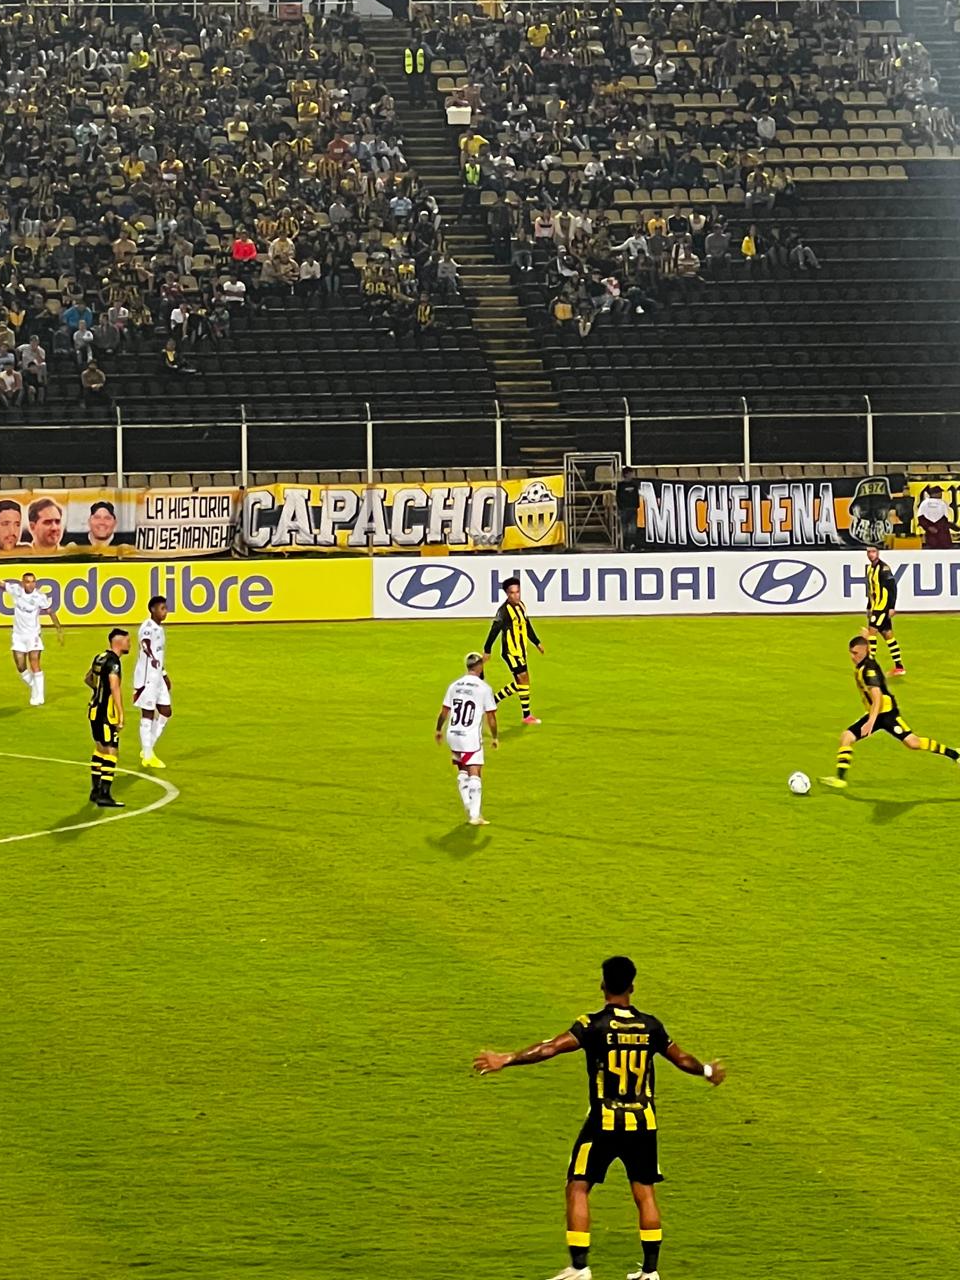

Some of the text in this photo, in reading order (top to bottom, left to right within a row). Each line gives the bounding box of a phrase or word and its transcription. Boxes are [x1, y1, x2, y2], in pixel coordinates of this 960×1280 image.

[146, 496, 230, 519] LA HISTORIA
[243, 486, 506, 547] CAPACHO
[640, 482, 838, 546] MICHELENA
[136, 526, 155, 550] NO
[159, 527, 177, 550] SE
[150, 565, 274, 613] libre
[491, 566, 716, 603] HYUNDAI
[451, 698, 476, 727] 30
[608, 1050, 648, 1096] 44
